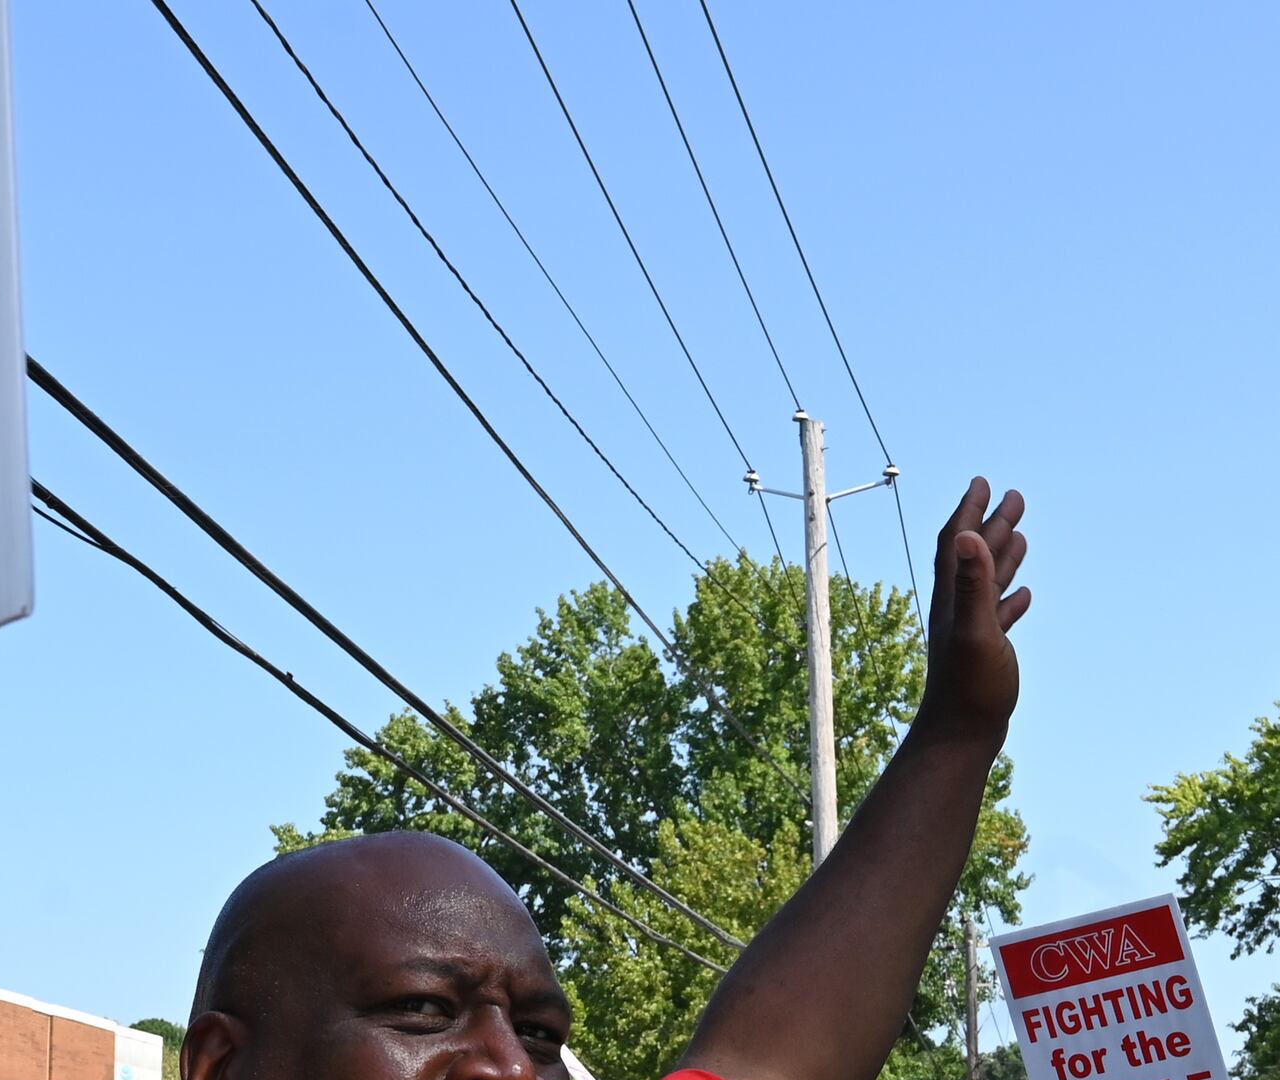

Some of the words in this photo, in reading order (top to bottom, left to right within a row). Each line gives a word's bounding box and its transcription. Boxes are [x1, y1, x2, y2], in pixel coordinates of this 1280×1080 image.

[1030, 923, 1156, 983] CWA
[1022, 974, 1194, 1044] FIGHTING
[1121, 1030, 1192, 1068] the
